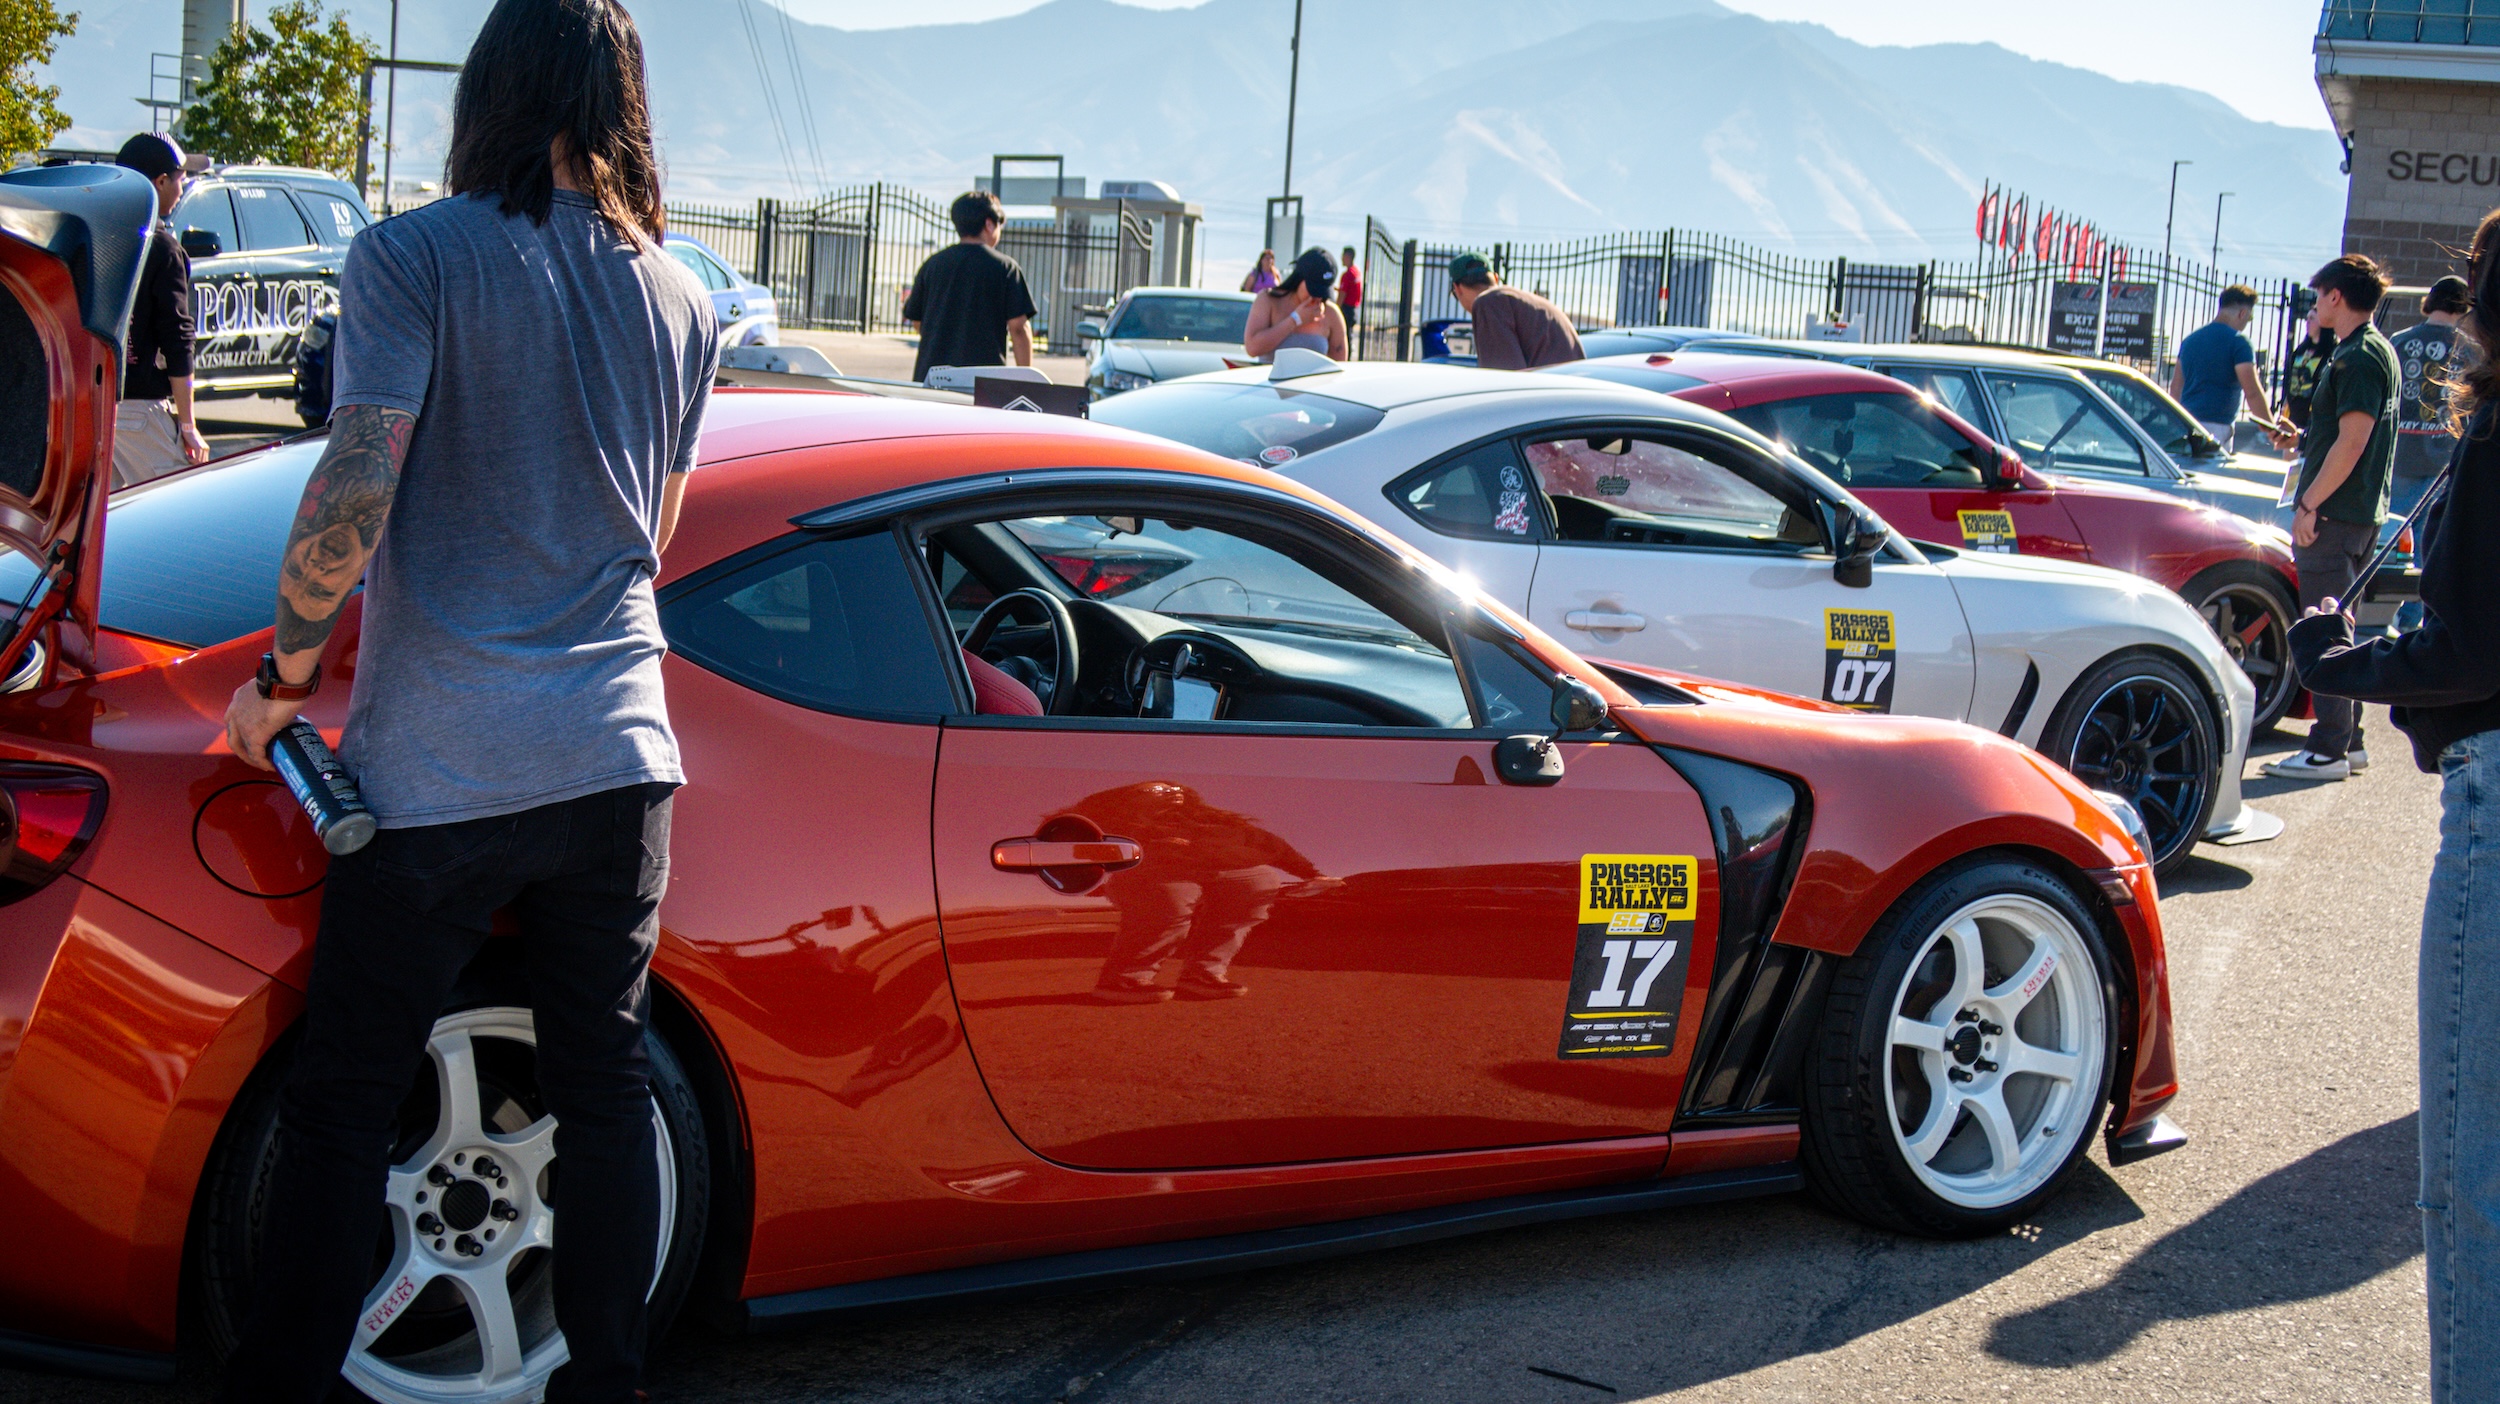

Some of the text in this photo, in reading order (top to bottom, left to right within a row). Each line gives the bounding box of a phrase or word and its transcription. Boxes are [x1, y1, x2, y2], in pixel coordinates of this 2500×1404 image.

[2387, 150, 2500, 186] SECU
[329, 202, 351, 225] K9
[335, 224, 355, 238] UNIT
[194, 280, 325, 339] POLICE
[2064, 313, 2140, 326] EXIT HERE
[2055, 335, 2069, 344] We
[2071, 336, 2092, 347] hope
[2128, 338, 2144, 347] you
[2075, 325, 2097, 335] Drive
[194, 351, 269, 369] ANTSVILLE CITY
[1831, 627, 1878, 642] RALLY
[1831, 659, 1892, 702] 07
[1590, 886, 1667, 909] RALLY
[1586, 940, 1678, 1008] 17
[367, 1276, 414, 1331] gram
